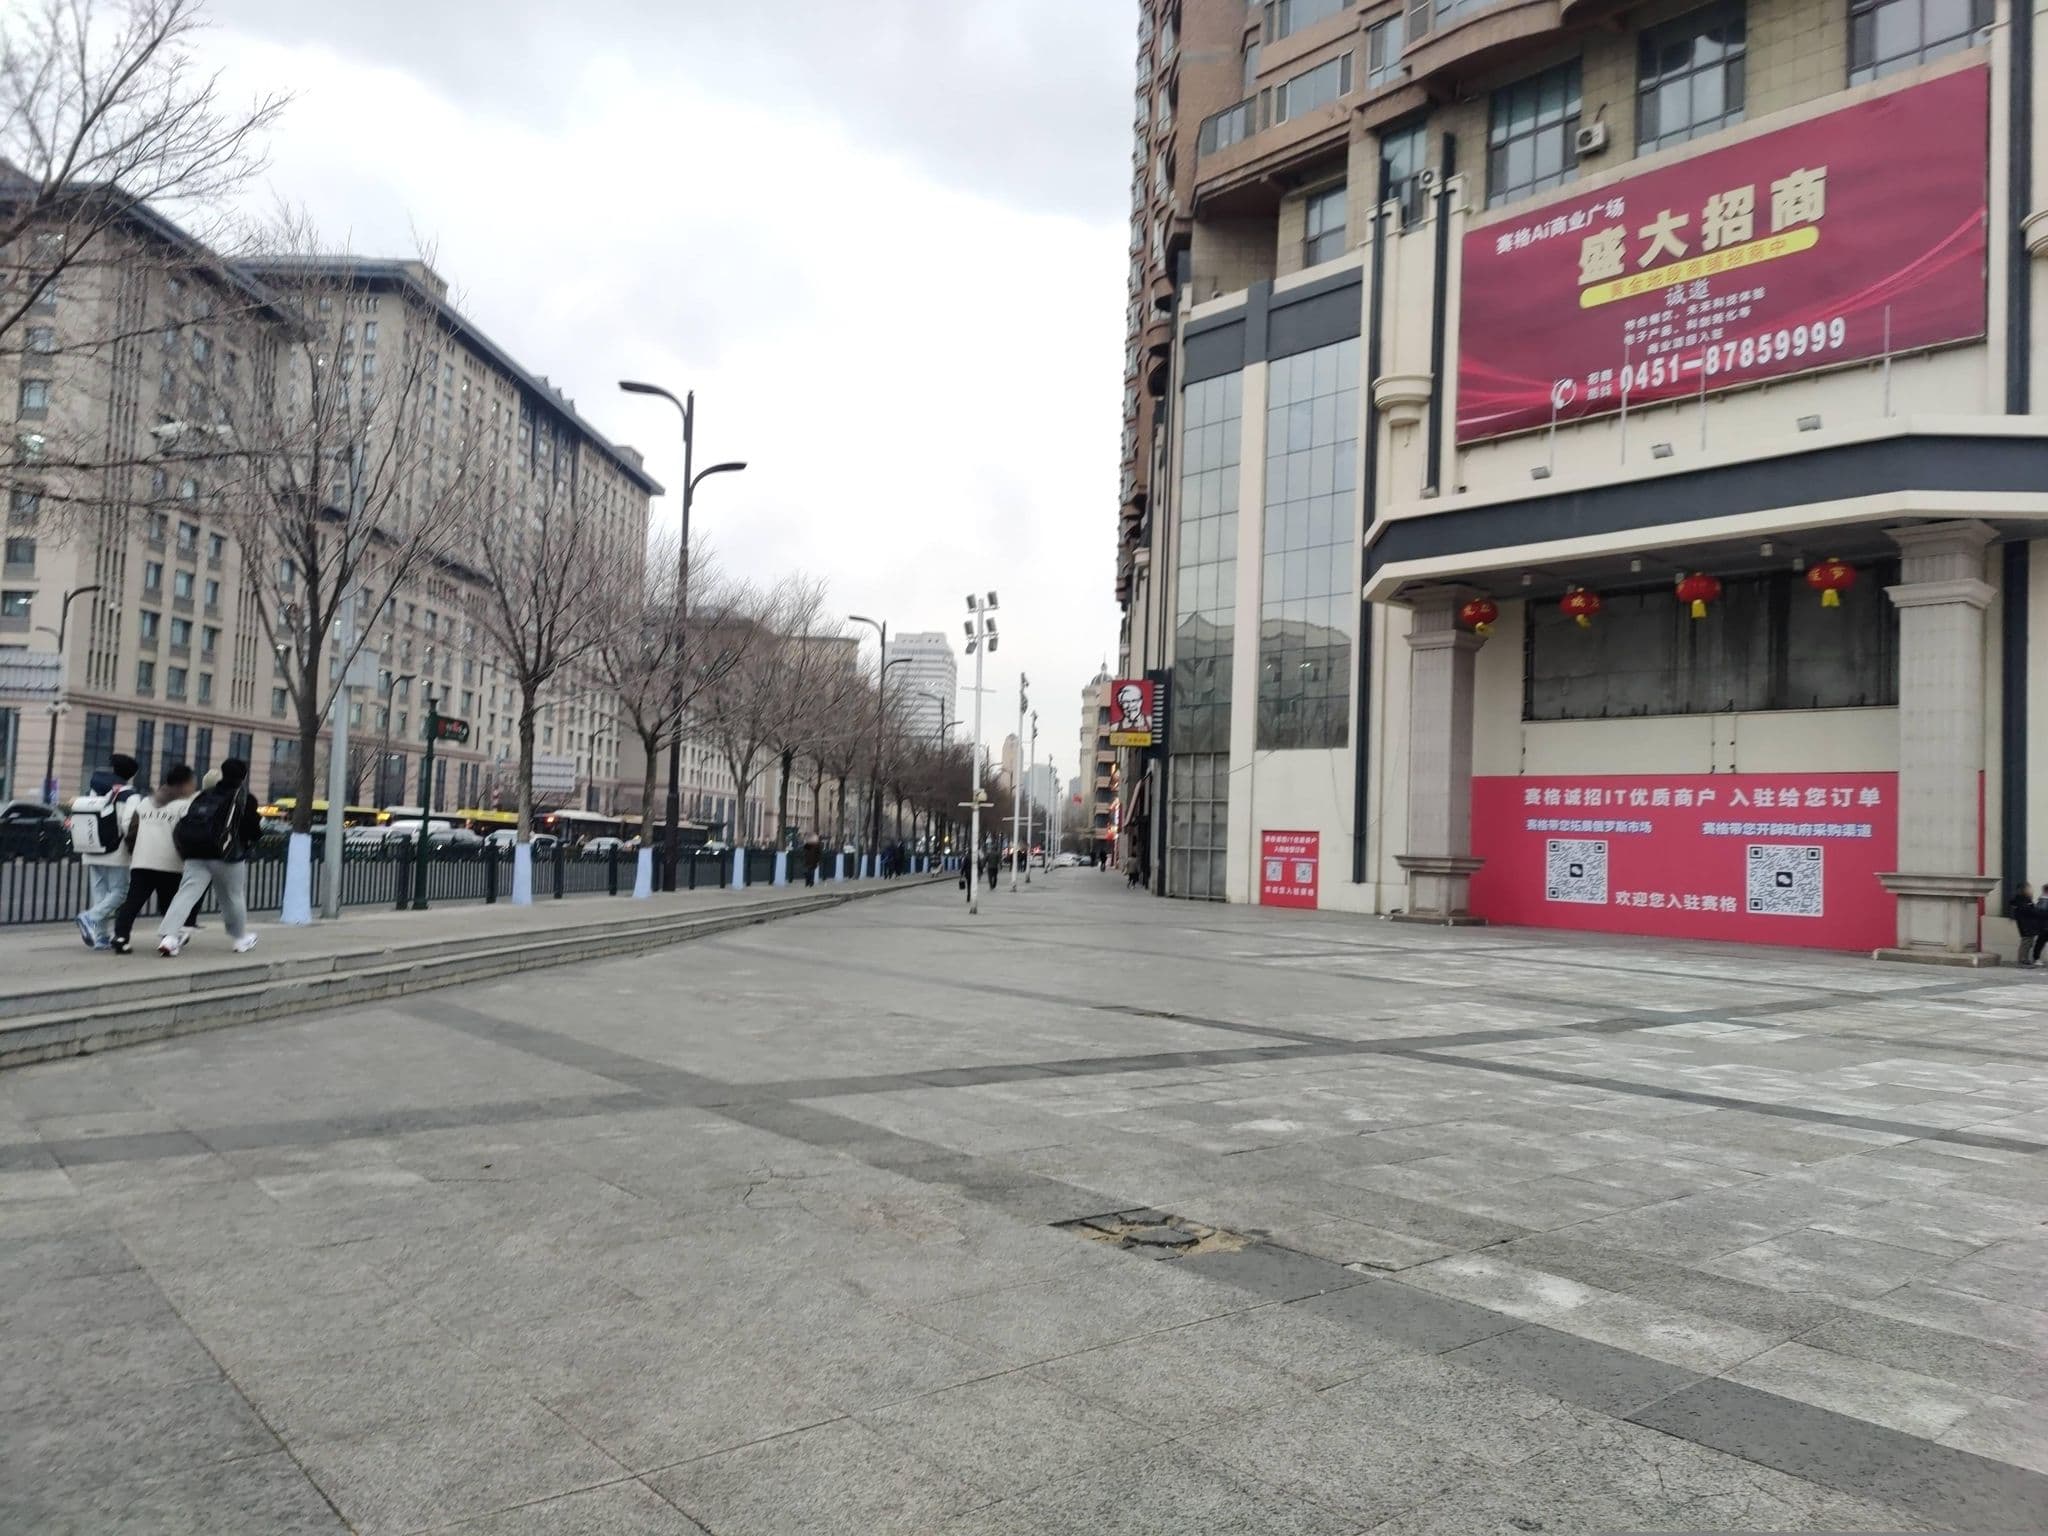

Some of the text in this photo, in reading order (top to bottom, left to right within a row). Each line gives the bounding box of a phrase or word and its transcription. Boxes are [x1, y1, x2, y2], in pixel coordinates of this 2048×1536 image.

[1578, 166, 1828, 285] 盛大招商
[1524, 786, 1881, 808] 赛格诚招IT优质商户 入驻给您订单
[1615, 890, 1738, 913] 欢迎您入驻赛格
